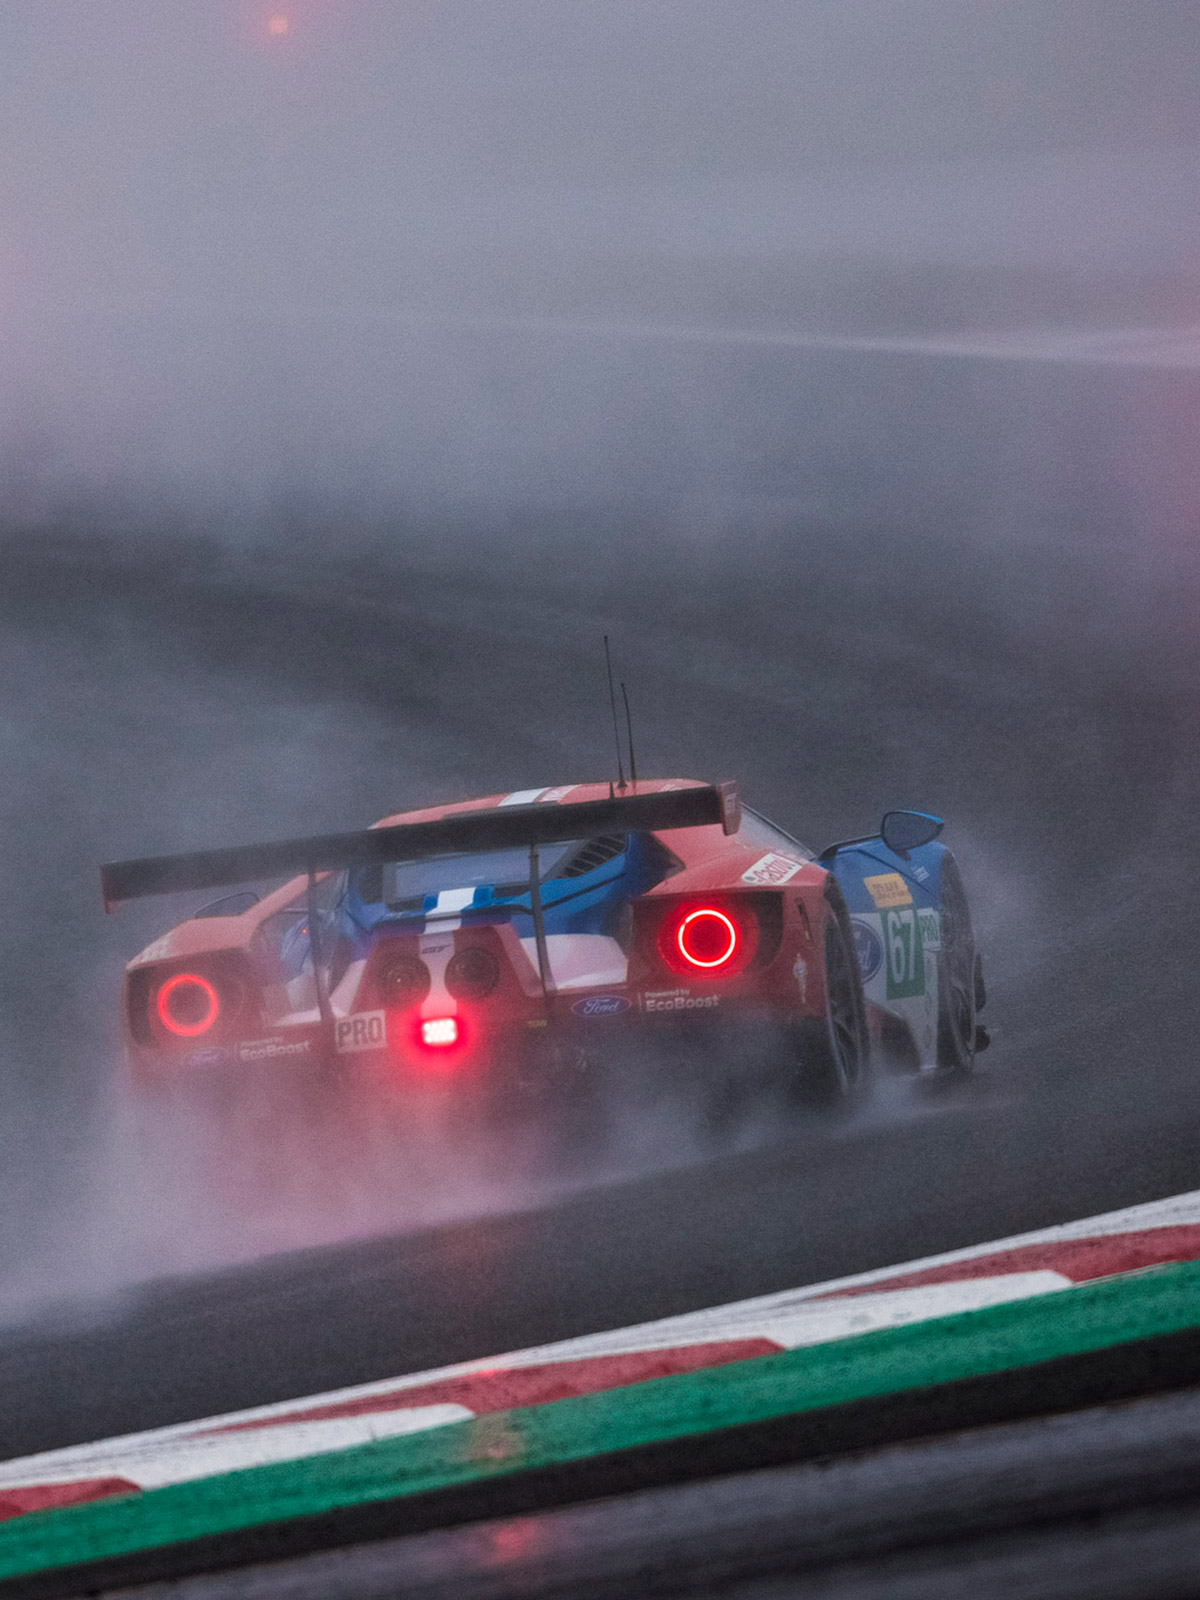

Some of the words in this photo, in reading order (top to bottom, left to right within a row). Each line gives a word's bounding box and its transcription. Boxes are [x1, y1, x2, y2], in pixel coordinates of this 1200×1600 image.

[920, 914, 940, 942] PRO
[887, 909, 915, 983] 67
[583, 998, 620, 1014] Ford
[646, 994, 720, 1012] EcoBoost
[337, 1016, 383, 1048] PRO
[240, 1040, 310, 1061] EcoBoost
